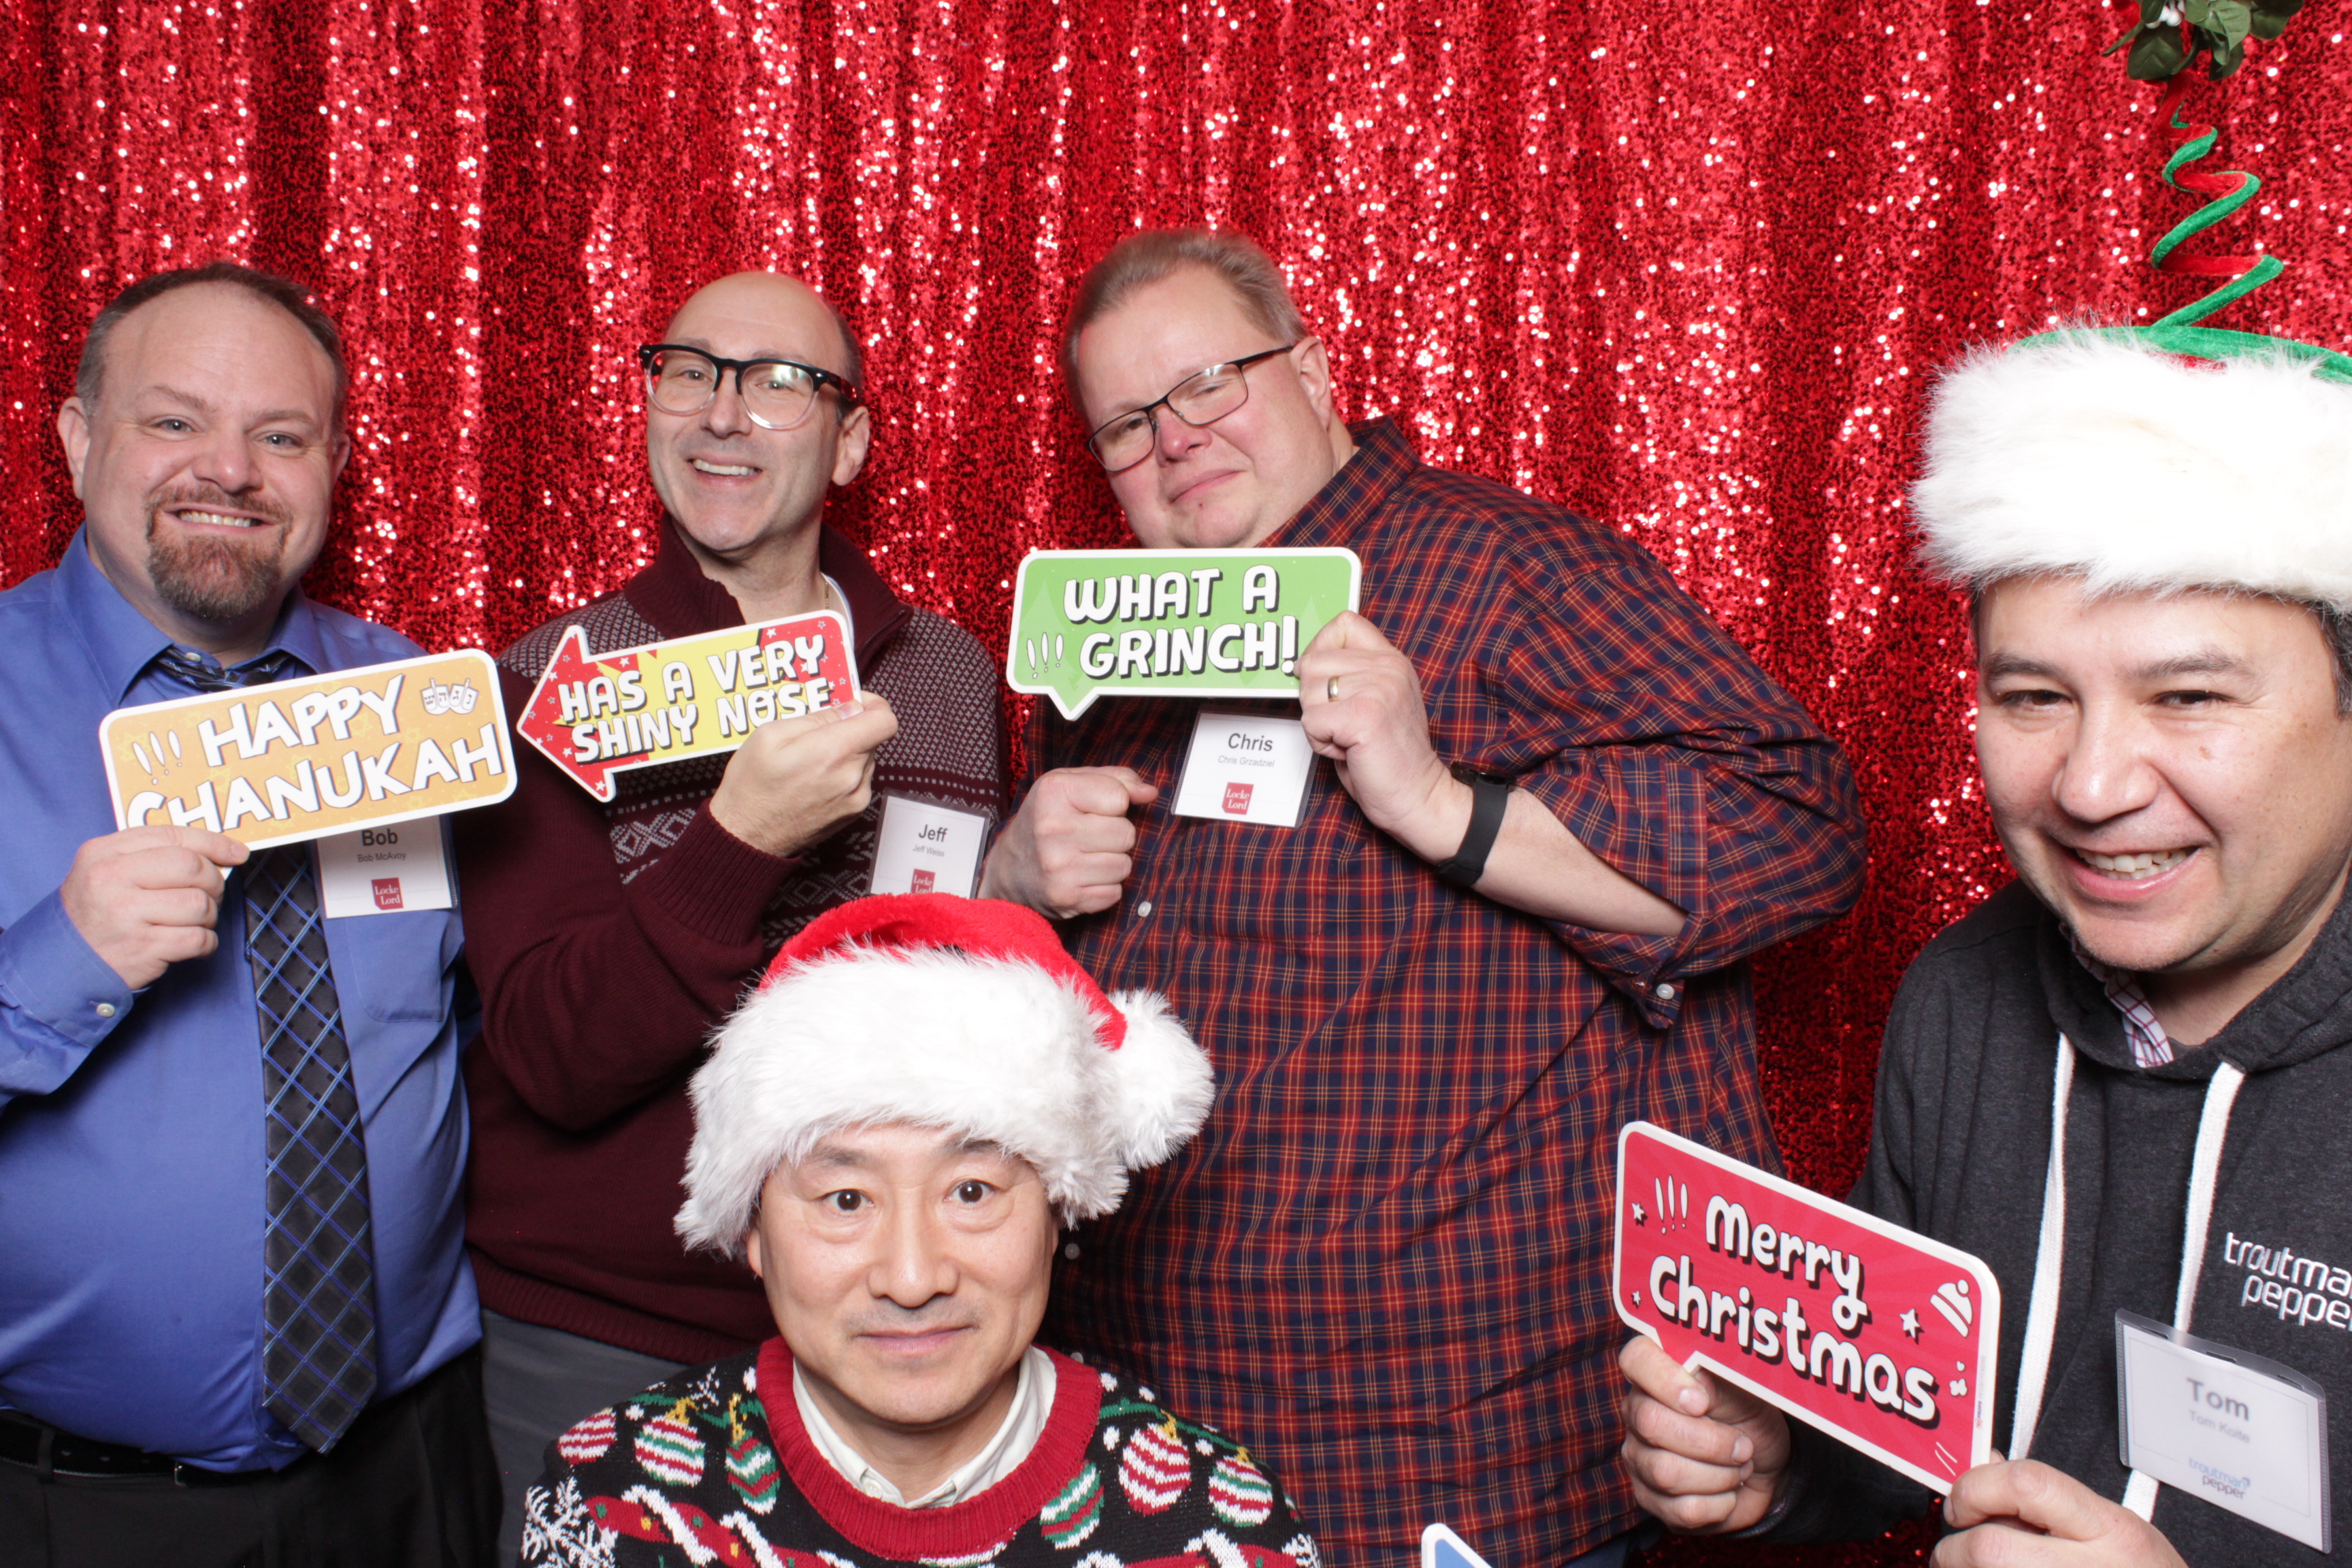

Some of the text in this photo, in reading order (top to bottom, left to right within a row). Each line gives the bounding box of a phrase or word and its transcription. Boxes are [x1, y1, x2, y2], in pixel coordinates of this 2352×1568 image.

[1064, 565, 1279, 625] WHAT A
[1079, 615, 1298, 679] GRINCH!
[557, 670, 647, 723] HAS
[662, 661, 696, 704] A
[706, 634, 825, 693] VERY
[197, 673, 405, 767] HAPPY
[571, 703, 698, 764] SHINY
[716, 677, 832, 737] NOSE
[1228, 732, 1273, 752] Chris
[1218, 755, 1238, 765] Chris
[127, 722, 504, 833] CHANUKAH
[1226, 788, 1250, 800] Locke
[1227, 799, 1247, 810] Lord
[361, 828, 399, 847] Bob
[918, 823, 948, 843] Jeff
[357, 851, 406, 862] Bob McAvoy
[913, 844, 926, 853] Jeff
[375, 885, 399, 896] Locke
[913, 875, 933, 885] Locke
[380, 894, 401, 905] Lord
[2223, 1232, 2352, 1300] troutma
[2241, 1275, 2352, 1332] peppe
[1650, 1255, 1940, 1429] Christmas
[2187, 1377, 2249, 1421] Tom
[2189, 1409, 2216, 1429] Tom
[2189, 1456, 2247, 1490] troutman
[2202, 1475, 2246, 1499] pepper
